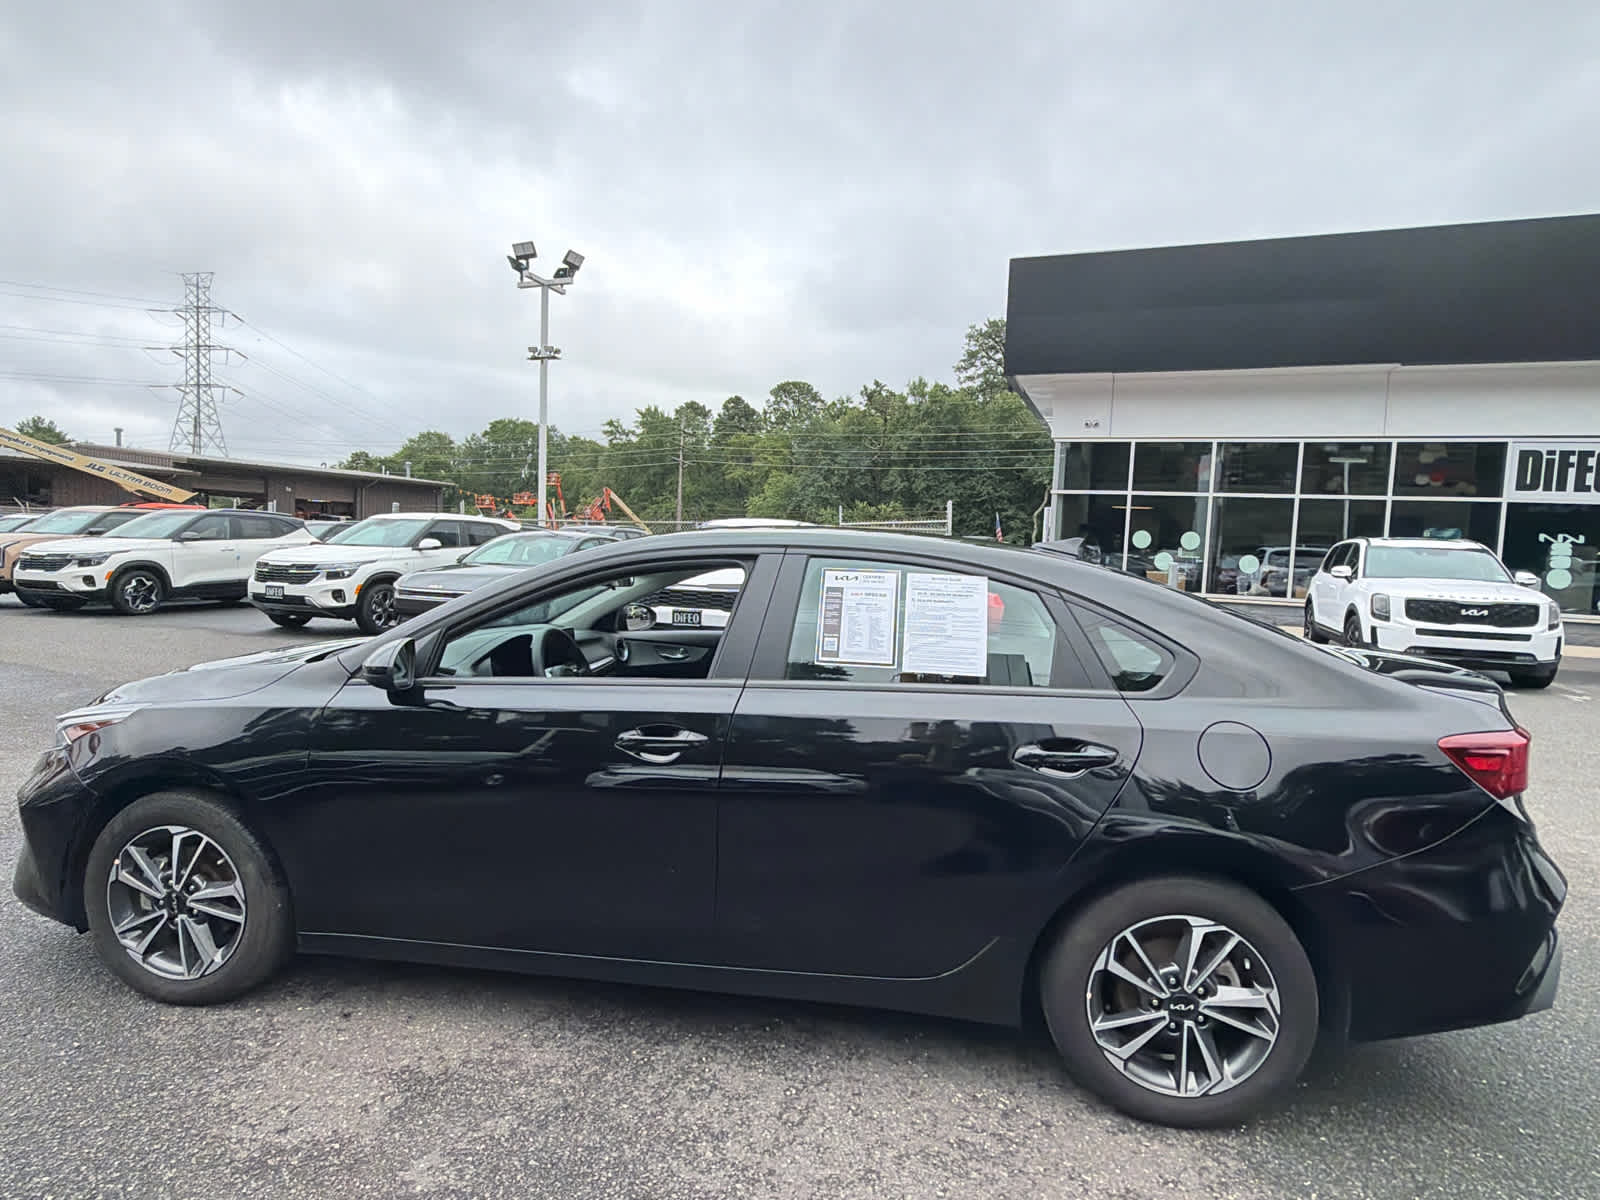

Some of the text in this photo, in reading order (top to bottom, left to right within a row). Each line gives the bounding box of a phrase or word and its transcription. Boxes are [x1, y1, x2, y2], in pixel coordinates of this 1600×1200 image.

[85, 462, 173, 494] JLG ULTRA BOOM
[674, 612, 700, 624] DiFEO
